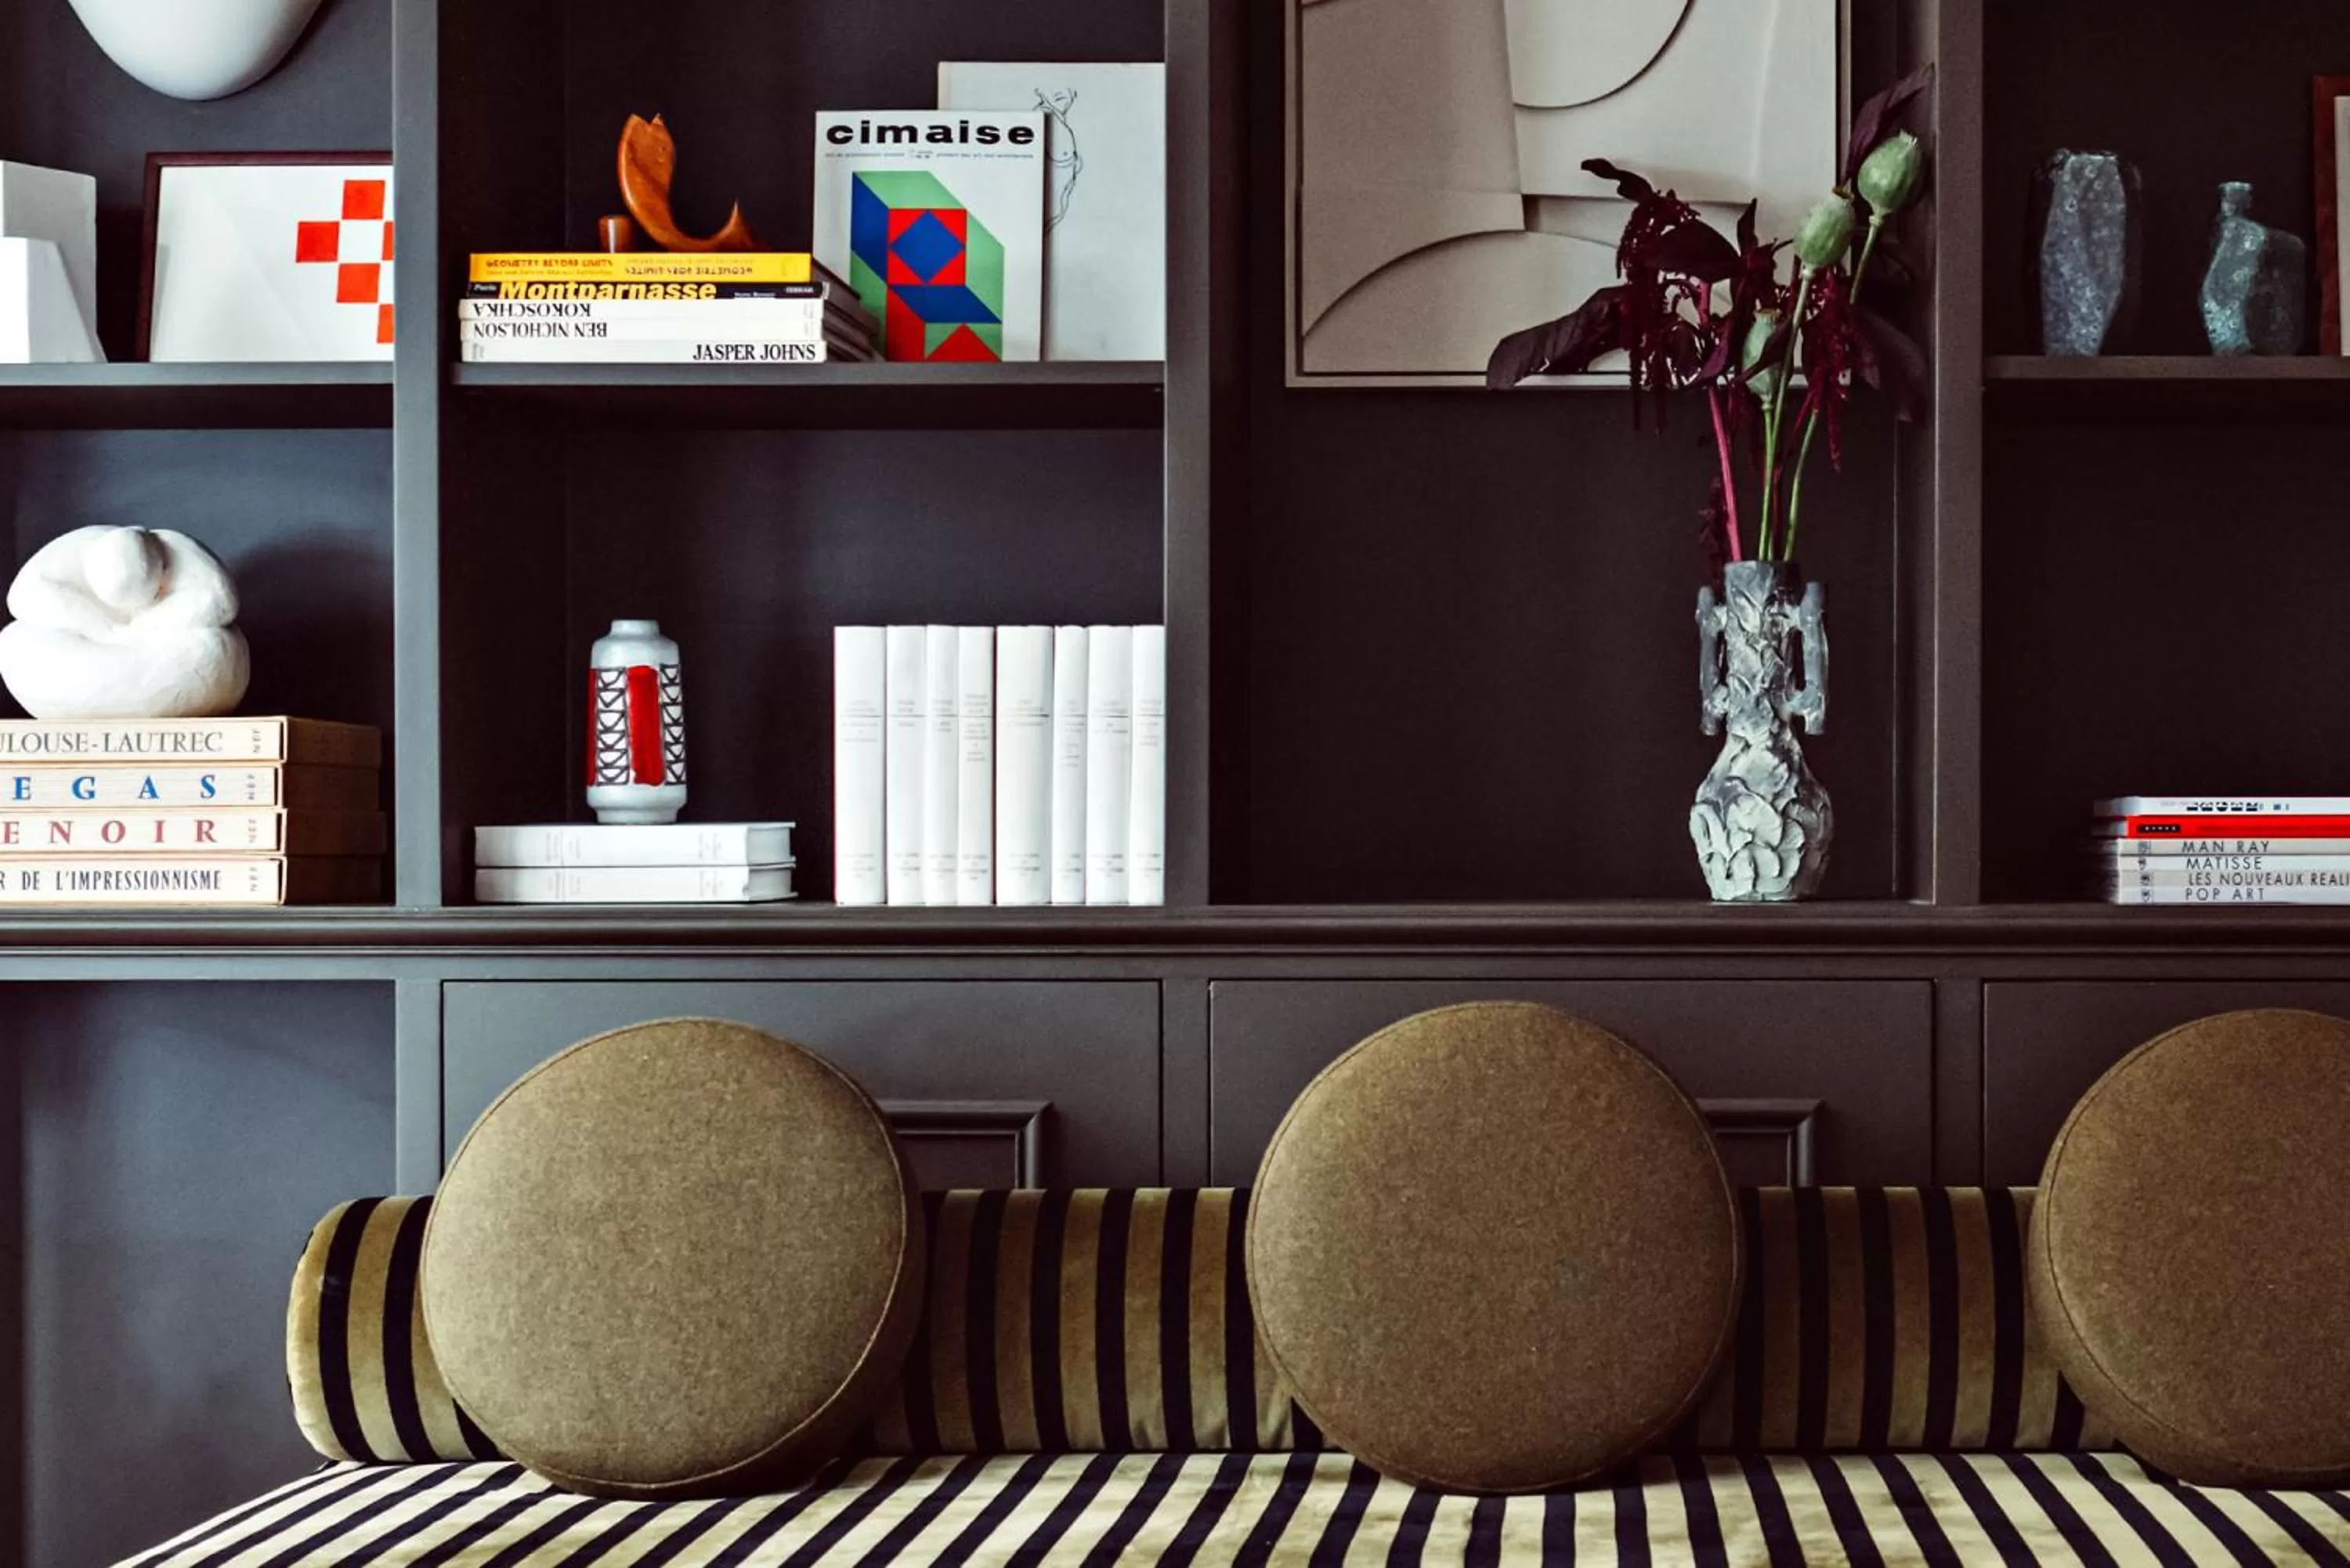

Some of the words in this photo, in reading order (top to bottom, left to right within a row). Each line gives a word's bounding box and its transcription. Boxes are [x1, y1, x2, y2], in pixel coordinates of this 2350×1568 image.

[826, 120, 1036, 146] cimaise
[498, 281, 717, 300] Montparnasse
[473, 303, 591, 317] KOKOSCHKA
[474, 322, 569, 338] NICHOLSON
[574, 322, 608, 338] BEN
[692, 344, 755, 361] JASPER
[760, 344, 815, 360] JOHNS
[2182, 840, 2225, 853] MAN
[2236, 840, 2269, 853] RAY
[2186, 857, 2262, 869] MATISSE
[22, 871, 40, 891] DE
[56, 870, 221, 891] L'IMPRESSIONNISME
[2189, 872, 2211, 886] LES
[2219, 872, 2303, 886] NOUVEAUX
[2186, 887, 2221, 901] POP
[2232, 887, 2265, 901] ART
